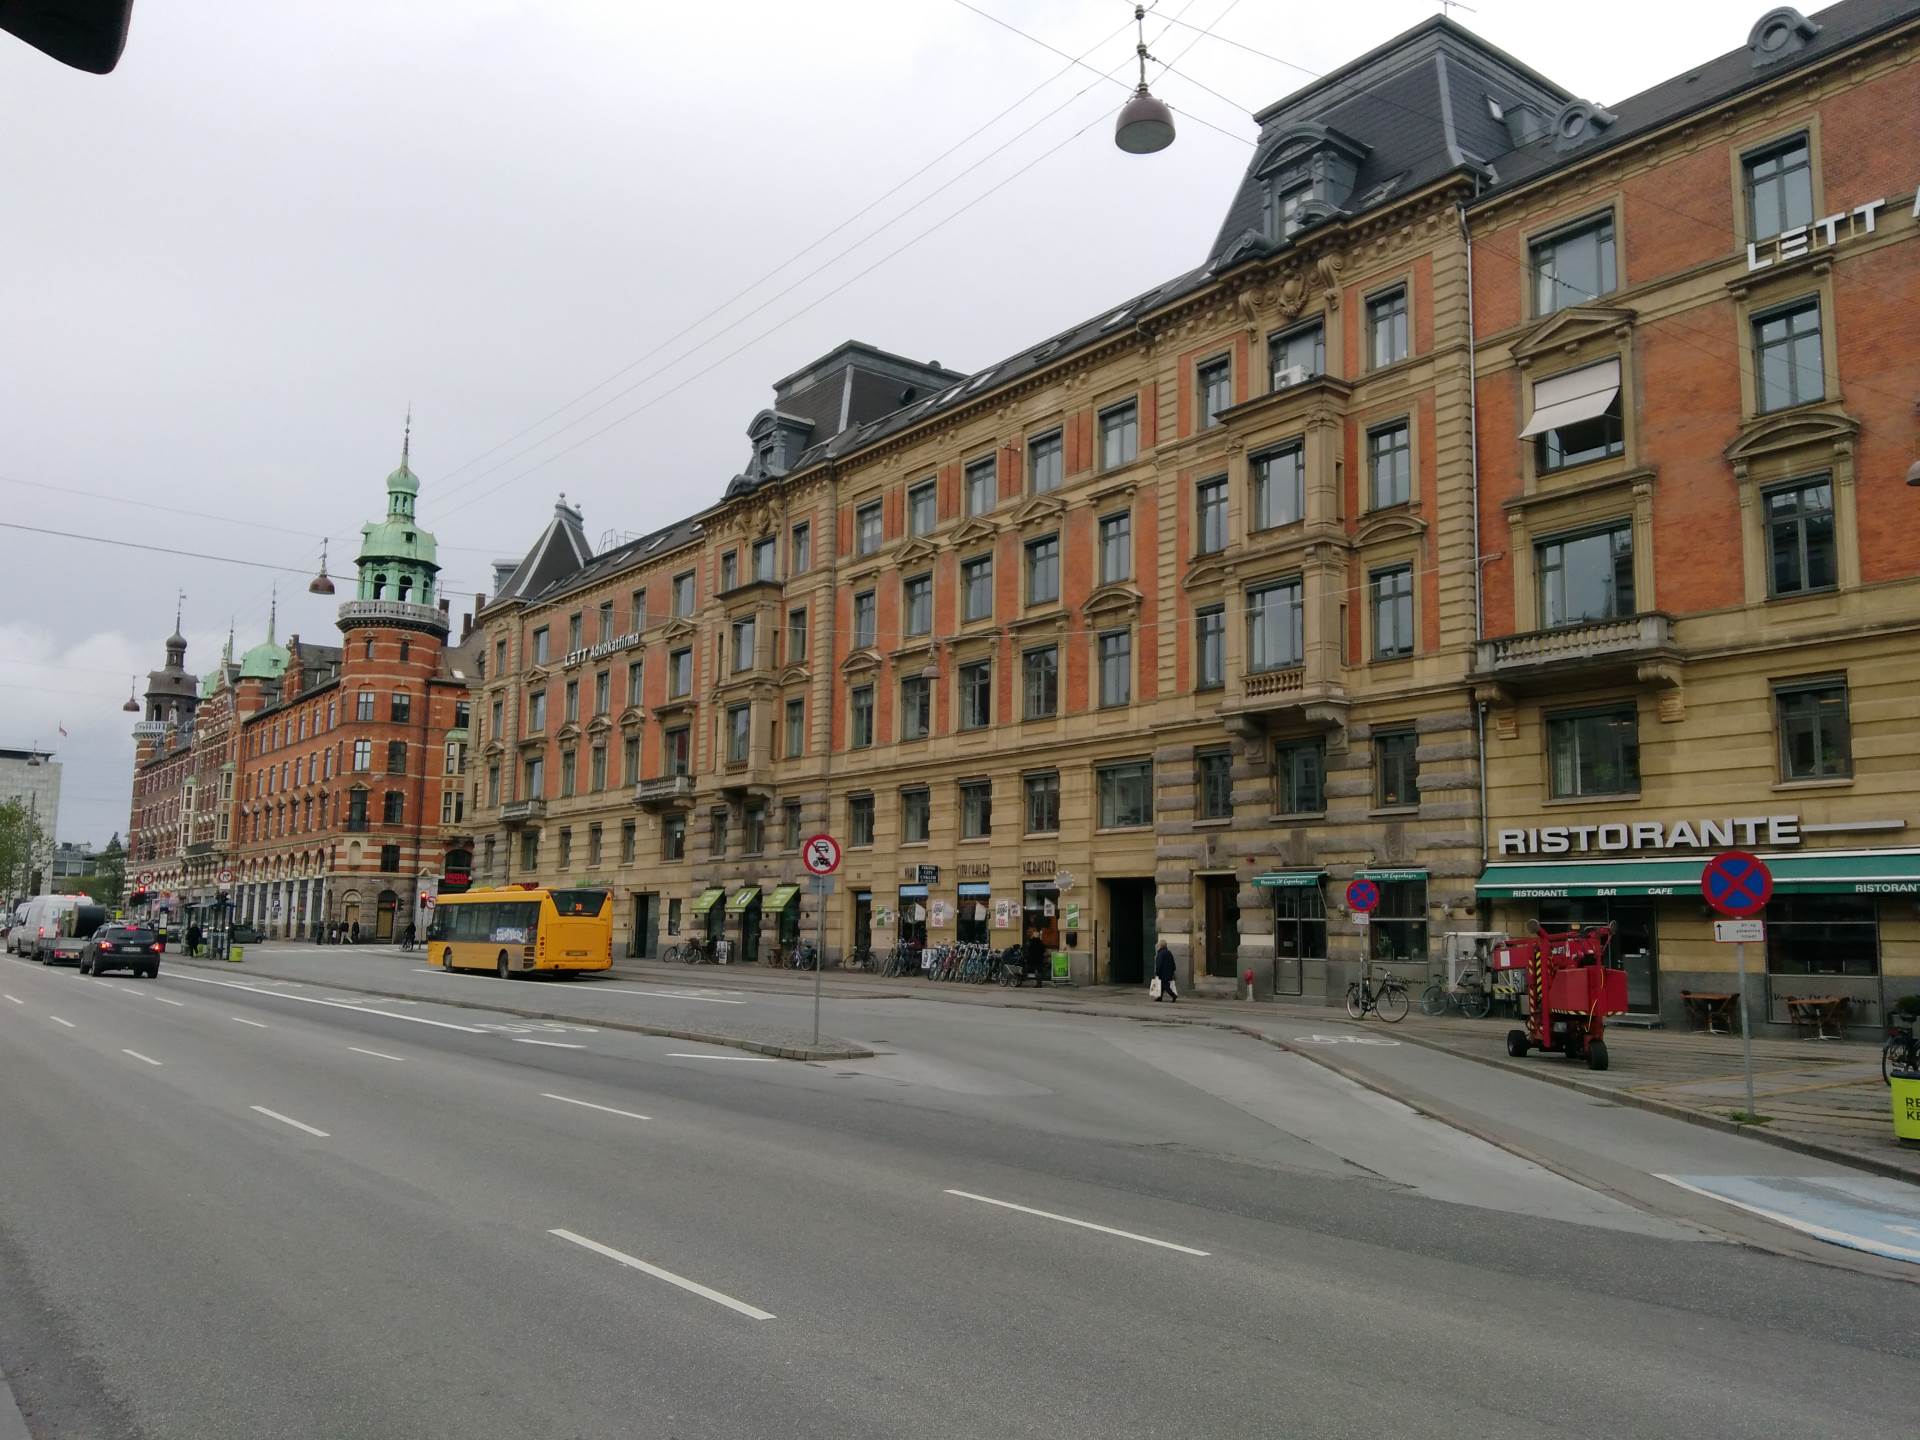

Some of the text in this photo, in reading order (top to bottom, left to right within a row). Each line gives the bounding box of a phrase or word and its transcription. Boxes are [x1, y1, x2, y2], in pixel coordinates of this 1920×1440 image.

[1747, 198, 1886, 272] LETT
[565, 633, 639, 666] LETT Advokatfirma
[1498, 815, 1800, 854] RISTORANTE
[1512, 887, 1673, 898] RISTORANTE BAR CAFE
